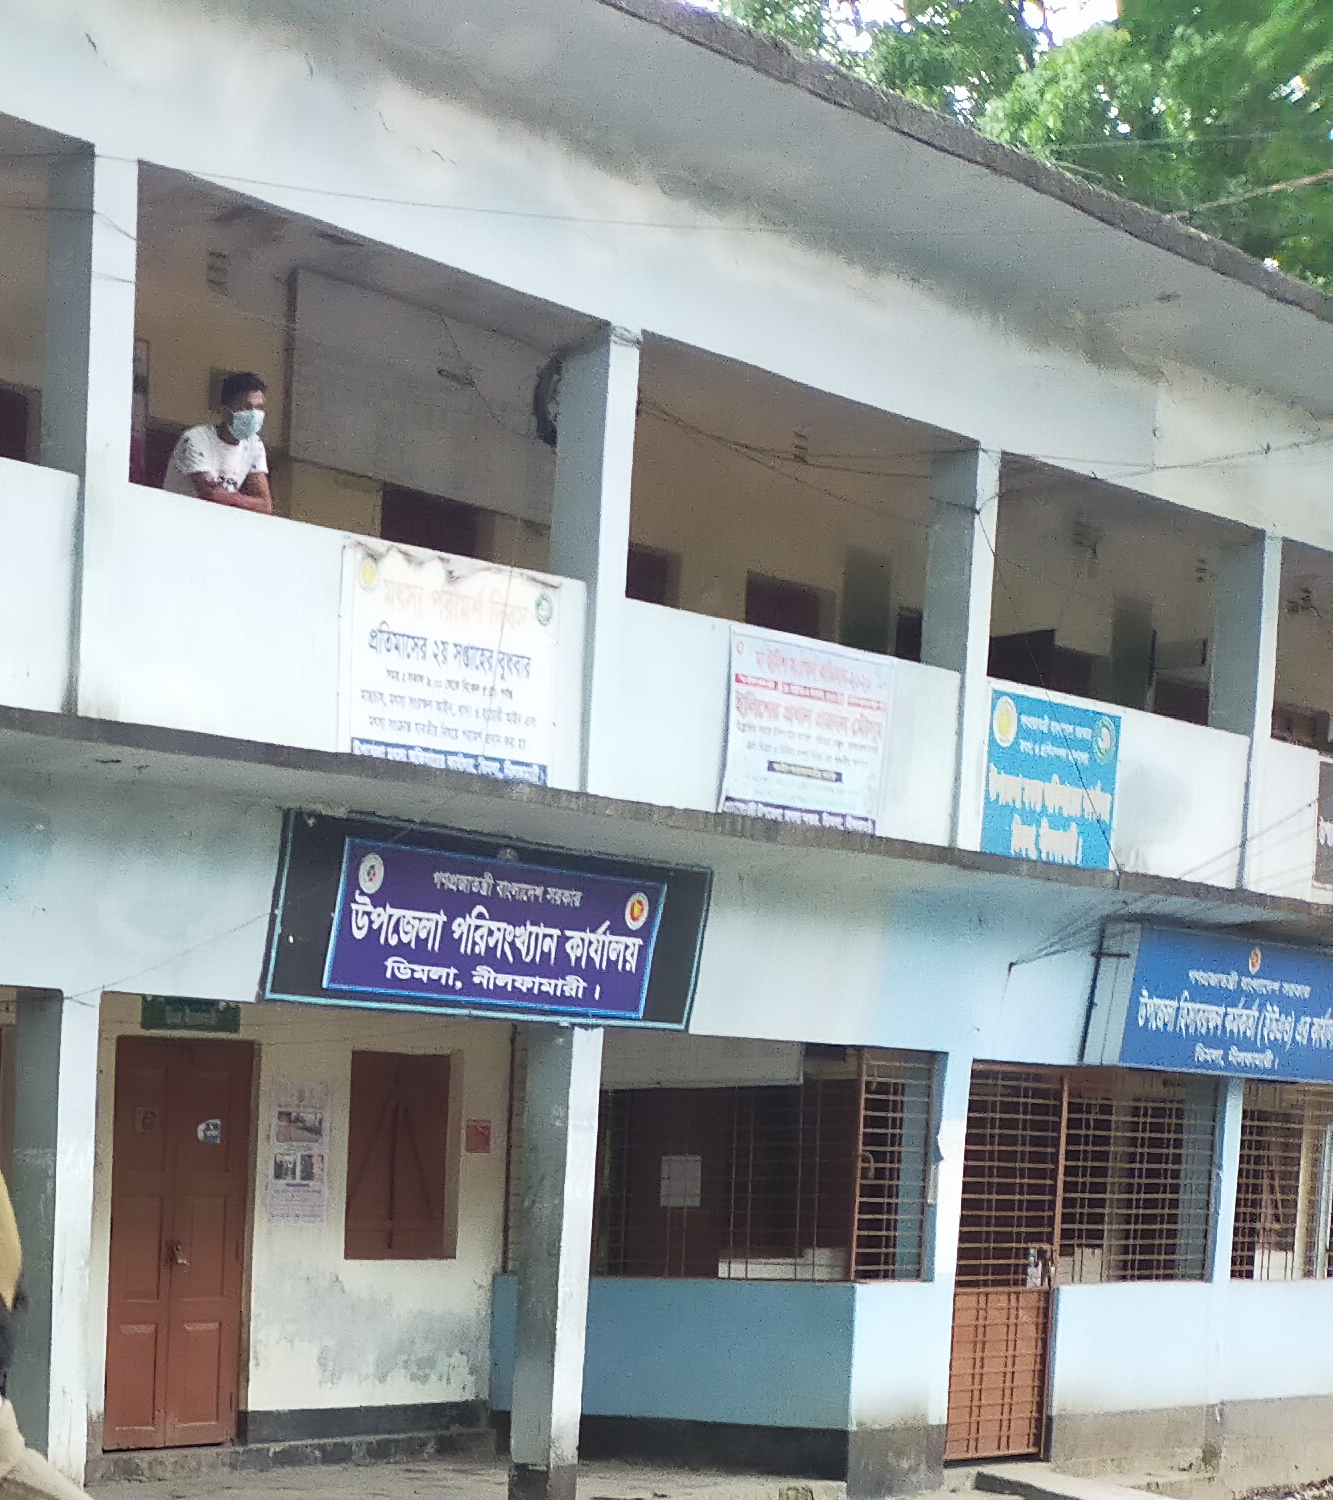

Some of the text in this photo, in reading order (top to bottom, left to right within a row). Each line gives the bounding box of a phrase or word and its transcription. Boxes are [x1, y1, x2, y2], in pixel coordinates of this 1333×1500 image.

[350, 890, 644, 974] উপজেলা পরিসংখ্যান কার্যালয়
[385, 956, 463, 991] ডিমলা,
